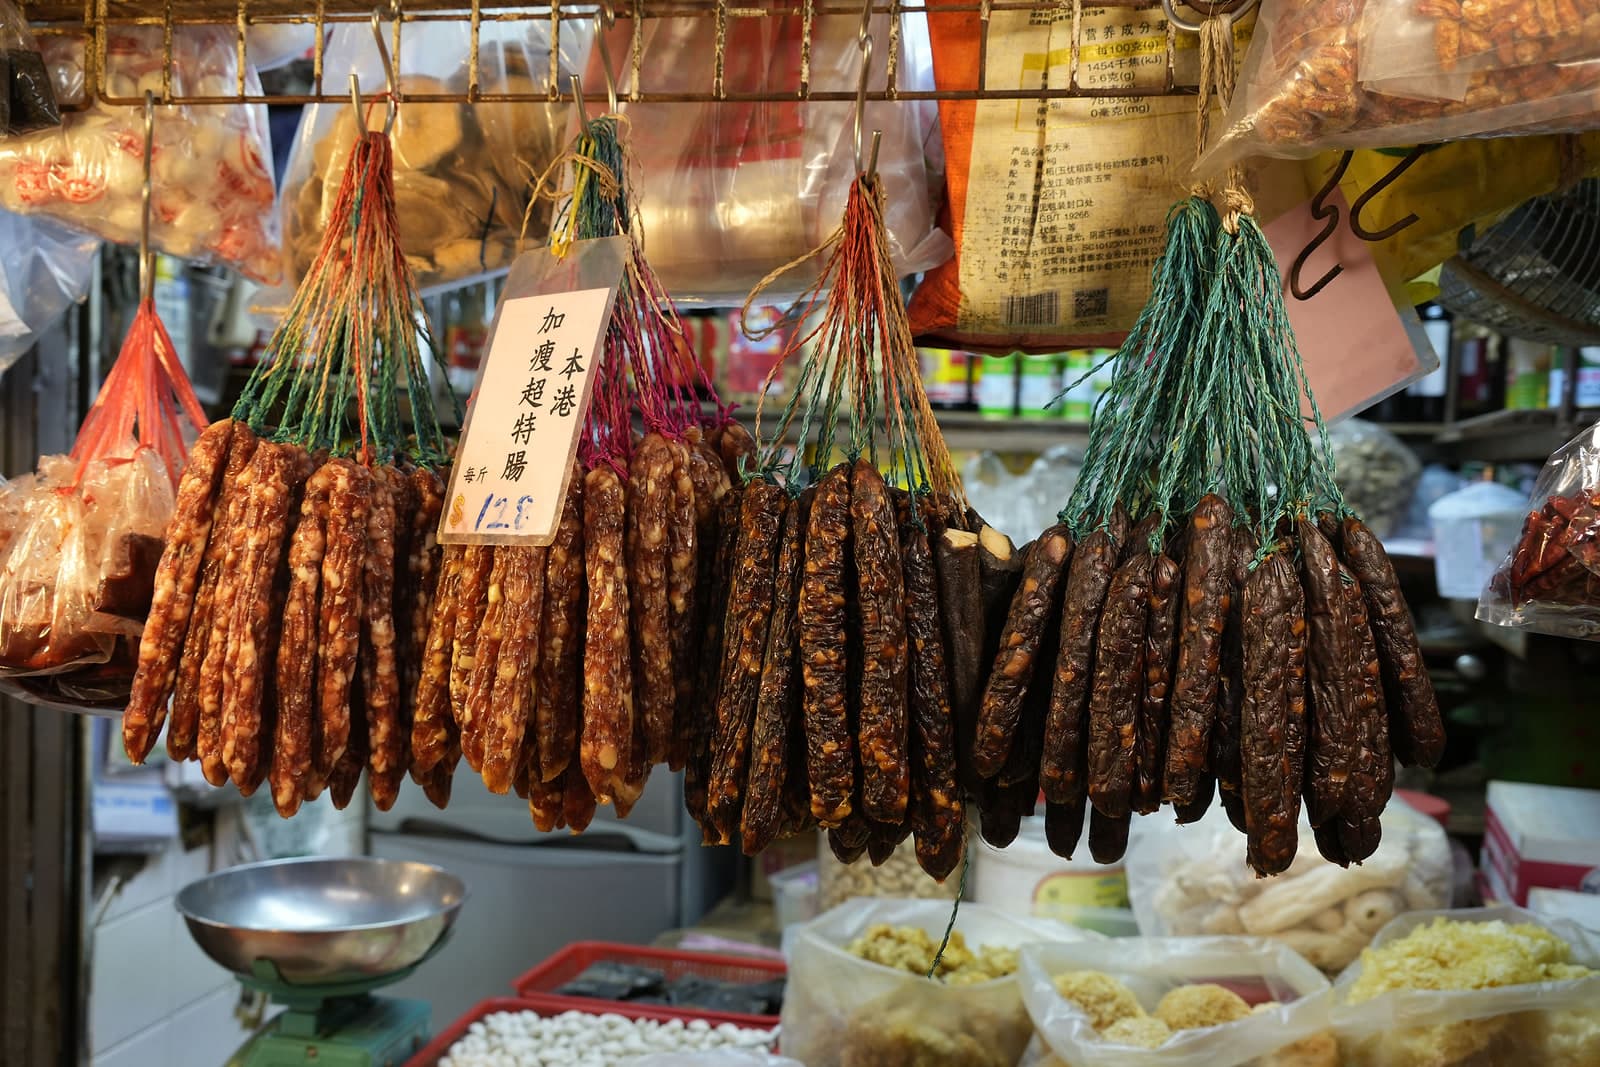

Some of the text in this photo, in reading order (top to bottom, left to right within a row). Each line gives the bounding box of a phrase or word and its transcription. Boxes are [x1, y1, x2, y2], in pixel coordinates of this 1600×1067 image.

[500, 306, 566, 482] 加瘦超特腸
[549, 347, 586, 418] 本港
[463, 466, 489, 484] 每斤
